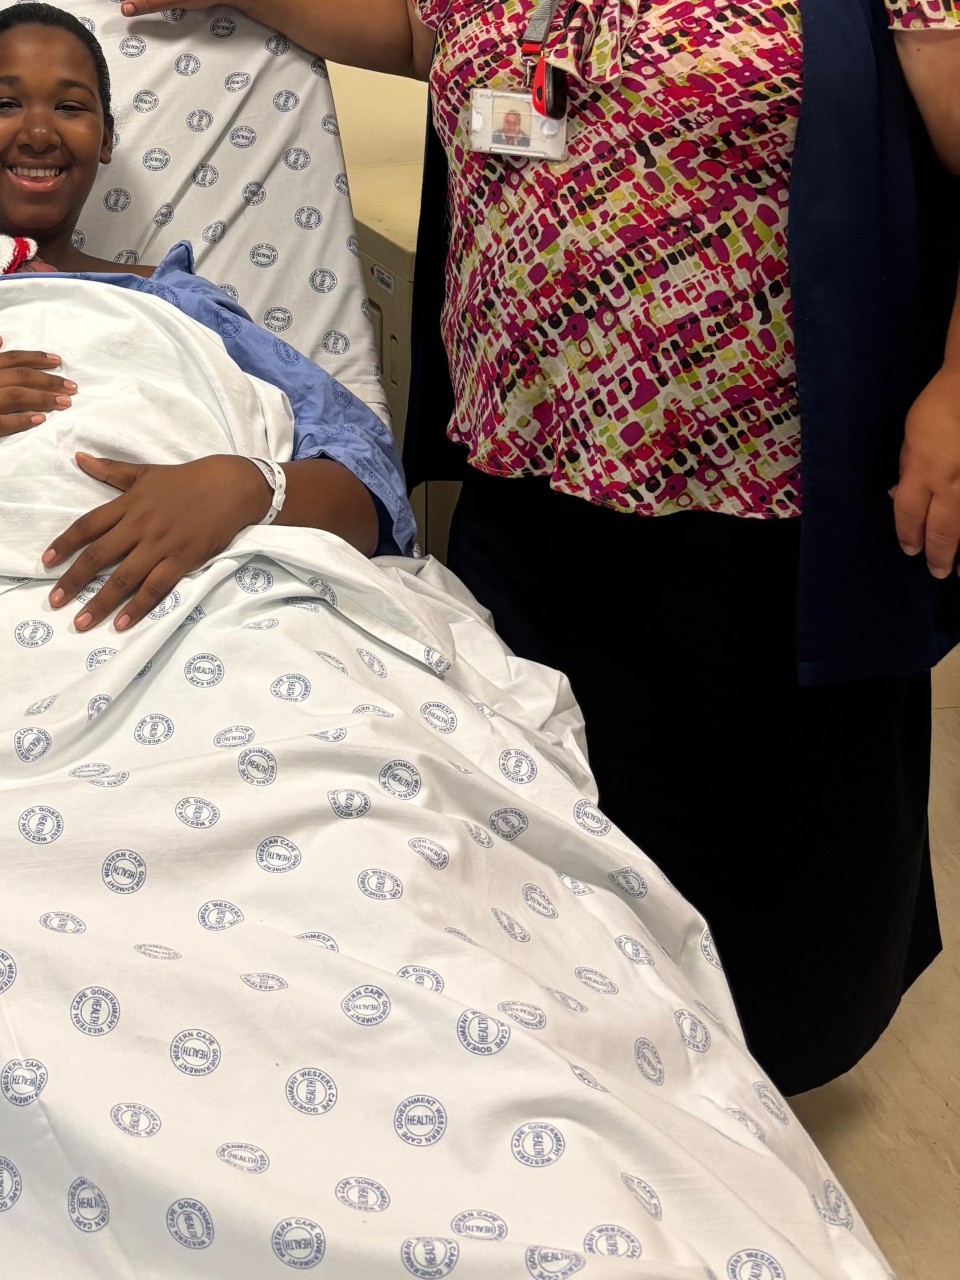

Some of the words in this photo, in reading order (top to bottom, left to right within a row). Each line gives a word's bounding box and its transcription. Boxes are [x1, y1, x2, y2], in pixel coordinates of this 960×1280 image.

[189, 674, 204, 686] CAPE
[194, 666, 215, 675] HEALTH
[240, 767, 254, 783] CAPE
[247, 758, 268, 774] HEALTH
[382, 780, 396, 796] CAPE
[390, 771, 411, 788] HEALTH
[22, 808, 38, 821] CAPE
[34, 814, 49, 834] HEALTH
[104, 852, 126, 878] WESTERN
[128, 853, 144, 870] CAPE
[107, 870, 145, 892] GOVERNMENT
[113, 865, 136, 880] HEALTH
[73, 991, 90, 1010] CAPE
[90, 989, 118, 1029] GOVERNMENT
[89, 999, 103, 1024] HEALTH
[73, 1012, 105, 1034] WESTERN
[173, 1031, 194, 1061] WESTERN
[196, 1032, 216, 1048] CAPE
[178, 1048, 219, 1074] GOVERNMENT
[183, 1046, 209, 1060] HEALTH
[24, 1058, 42, 1074] CAPE
[3, 1059, 22, 1093] WESTERN
[12, 1076, 36, 1087] HEALTH
[299, 1070, 334, 1091] WESTERN
[8, 1073, 45, 1103] GOVERNMENT
[288, 1075, 319, 1113] GOVERNMENT
[305, 1080, 316, 1104] HEALTH
[318, 1092, 335, 1111] CAPE
[396, 1097, 436, 1130] GOVERNMENT
[407, 1115, 434, 1126] HEALTH
[424, 1107, 444, 1143] WESTERN
[401, 1128, 422, 1144] CAPE
[514, 1129, 529, 1148] CAPE
[527, 1124, 562, 1157] GOVERNMENT
[532, 1132, 544, 1156] HEALTH
[515, 1148, 553, 1165] WESTERN
[7, 1180, 19, 1203] CAPE
[294, 1219, 316, 1234] CAPE
[274, 1221, 293, 1259] WESTERN
[285, 1238, 313, 1250] HEALTH
[285, 1232, 323, 1268] GOVERNMENT
